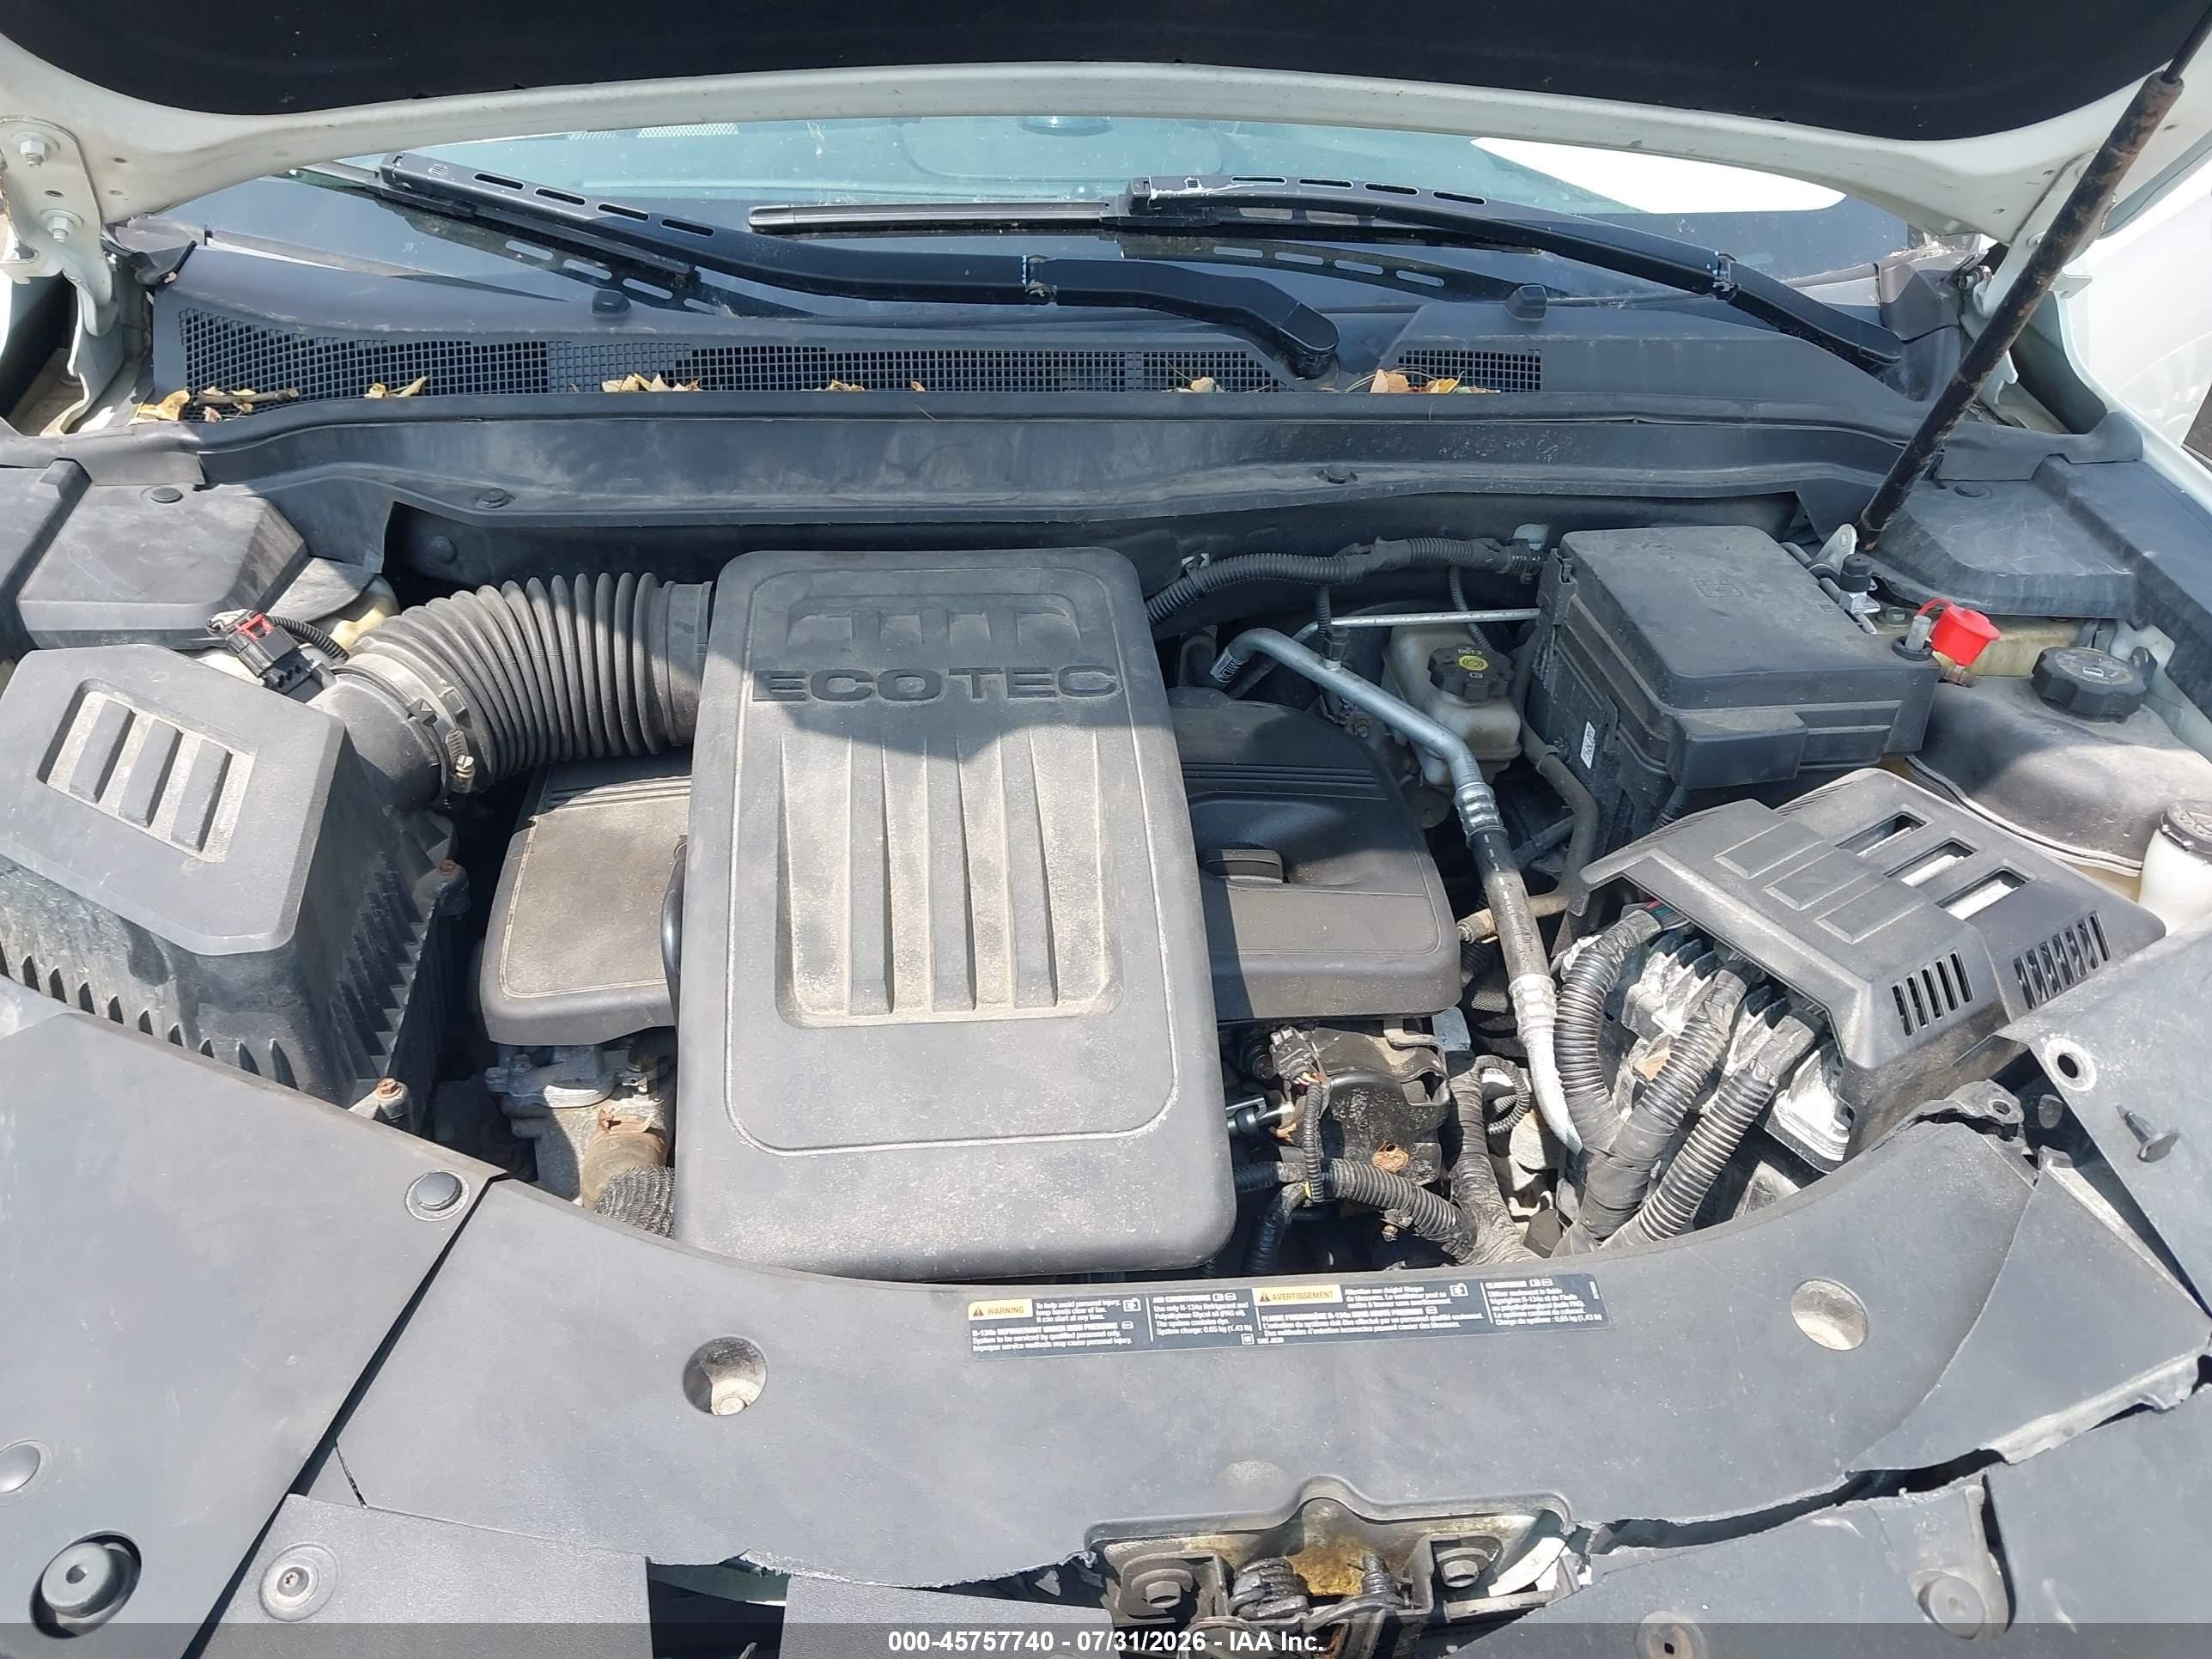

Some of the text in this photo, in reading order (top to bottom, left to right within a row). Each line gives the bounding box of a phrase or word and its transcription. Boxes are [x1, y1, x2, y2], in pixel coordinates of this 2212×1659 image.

[751, 665, 1122, 702] ECOTEC
[1272, 1291, 1334, 1301] AVERTISSEMENT
[988, 1306, 1024, 1315] WARNING
